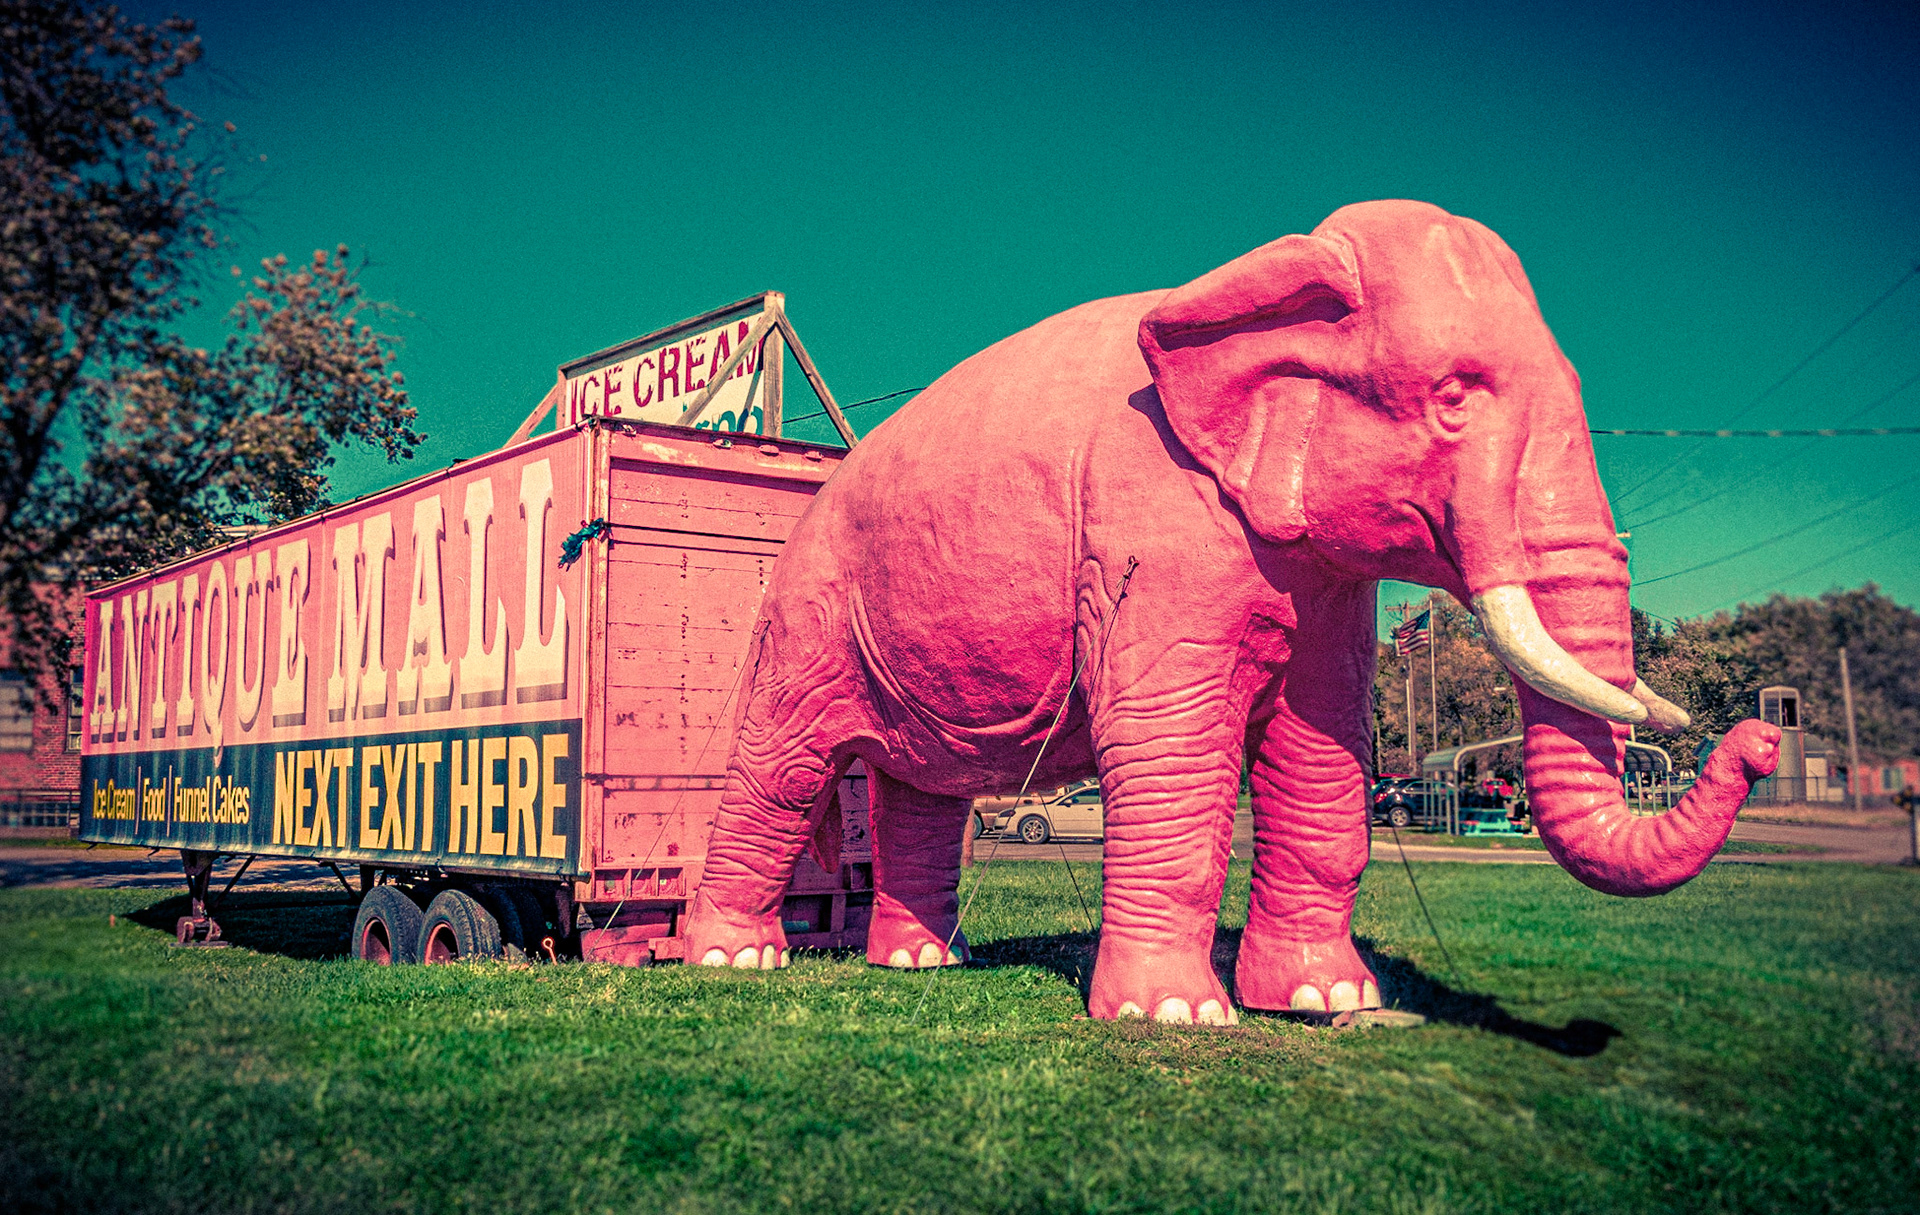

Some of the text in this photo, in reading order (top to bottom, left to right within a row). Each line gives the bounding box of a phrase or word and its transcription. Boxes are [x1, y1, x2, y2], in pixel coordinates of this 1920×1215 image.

[570, 363, 622, 426] ICE
[90, 458, 571, 766] ANTIQUE MALL
[92, 774, 250, 825] Ice Cream Food Funnel Cakes
[272, 733, 570, 859] NEXT EXIT HERE
